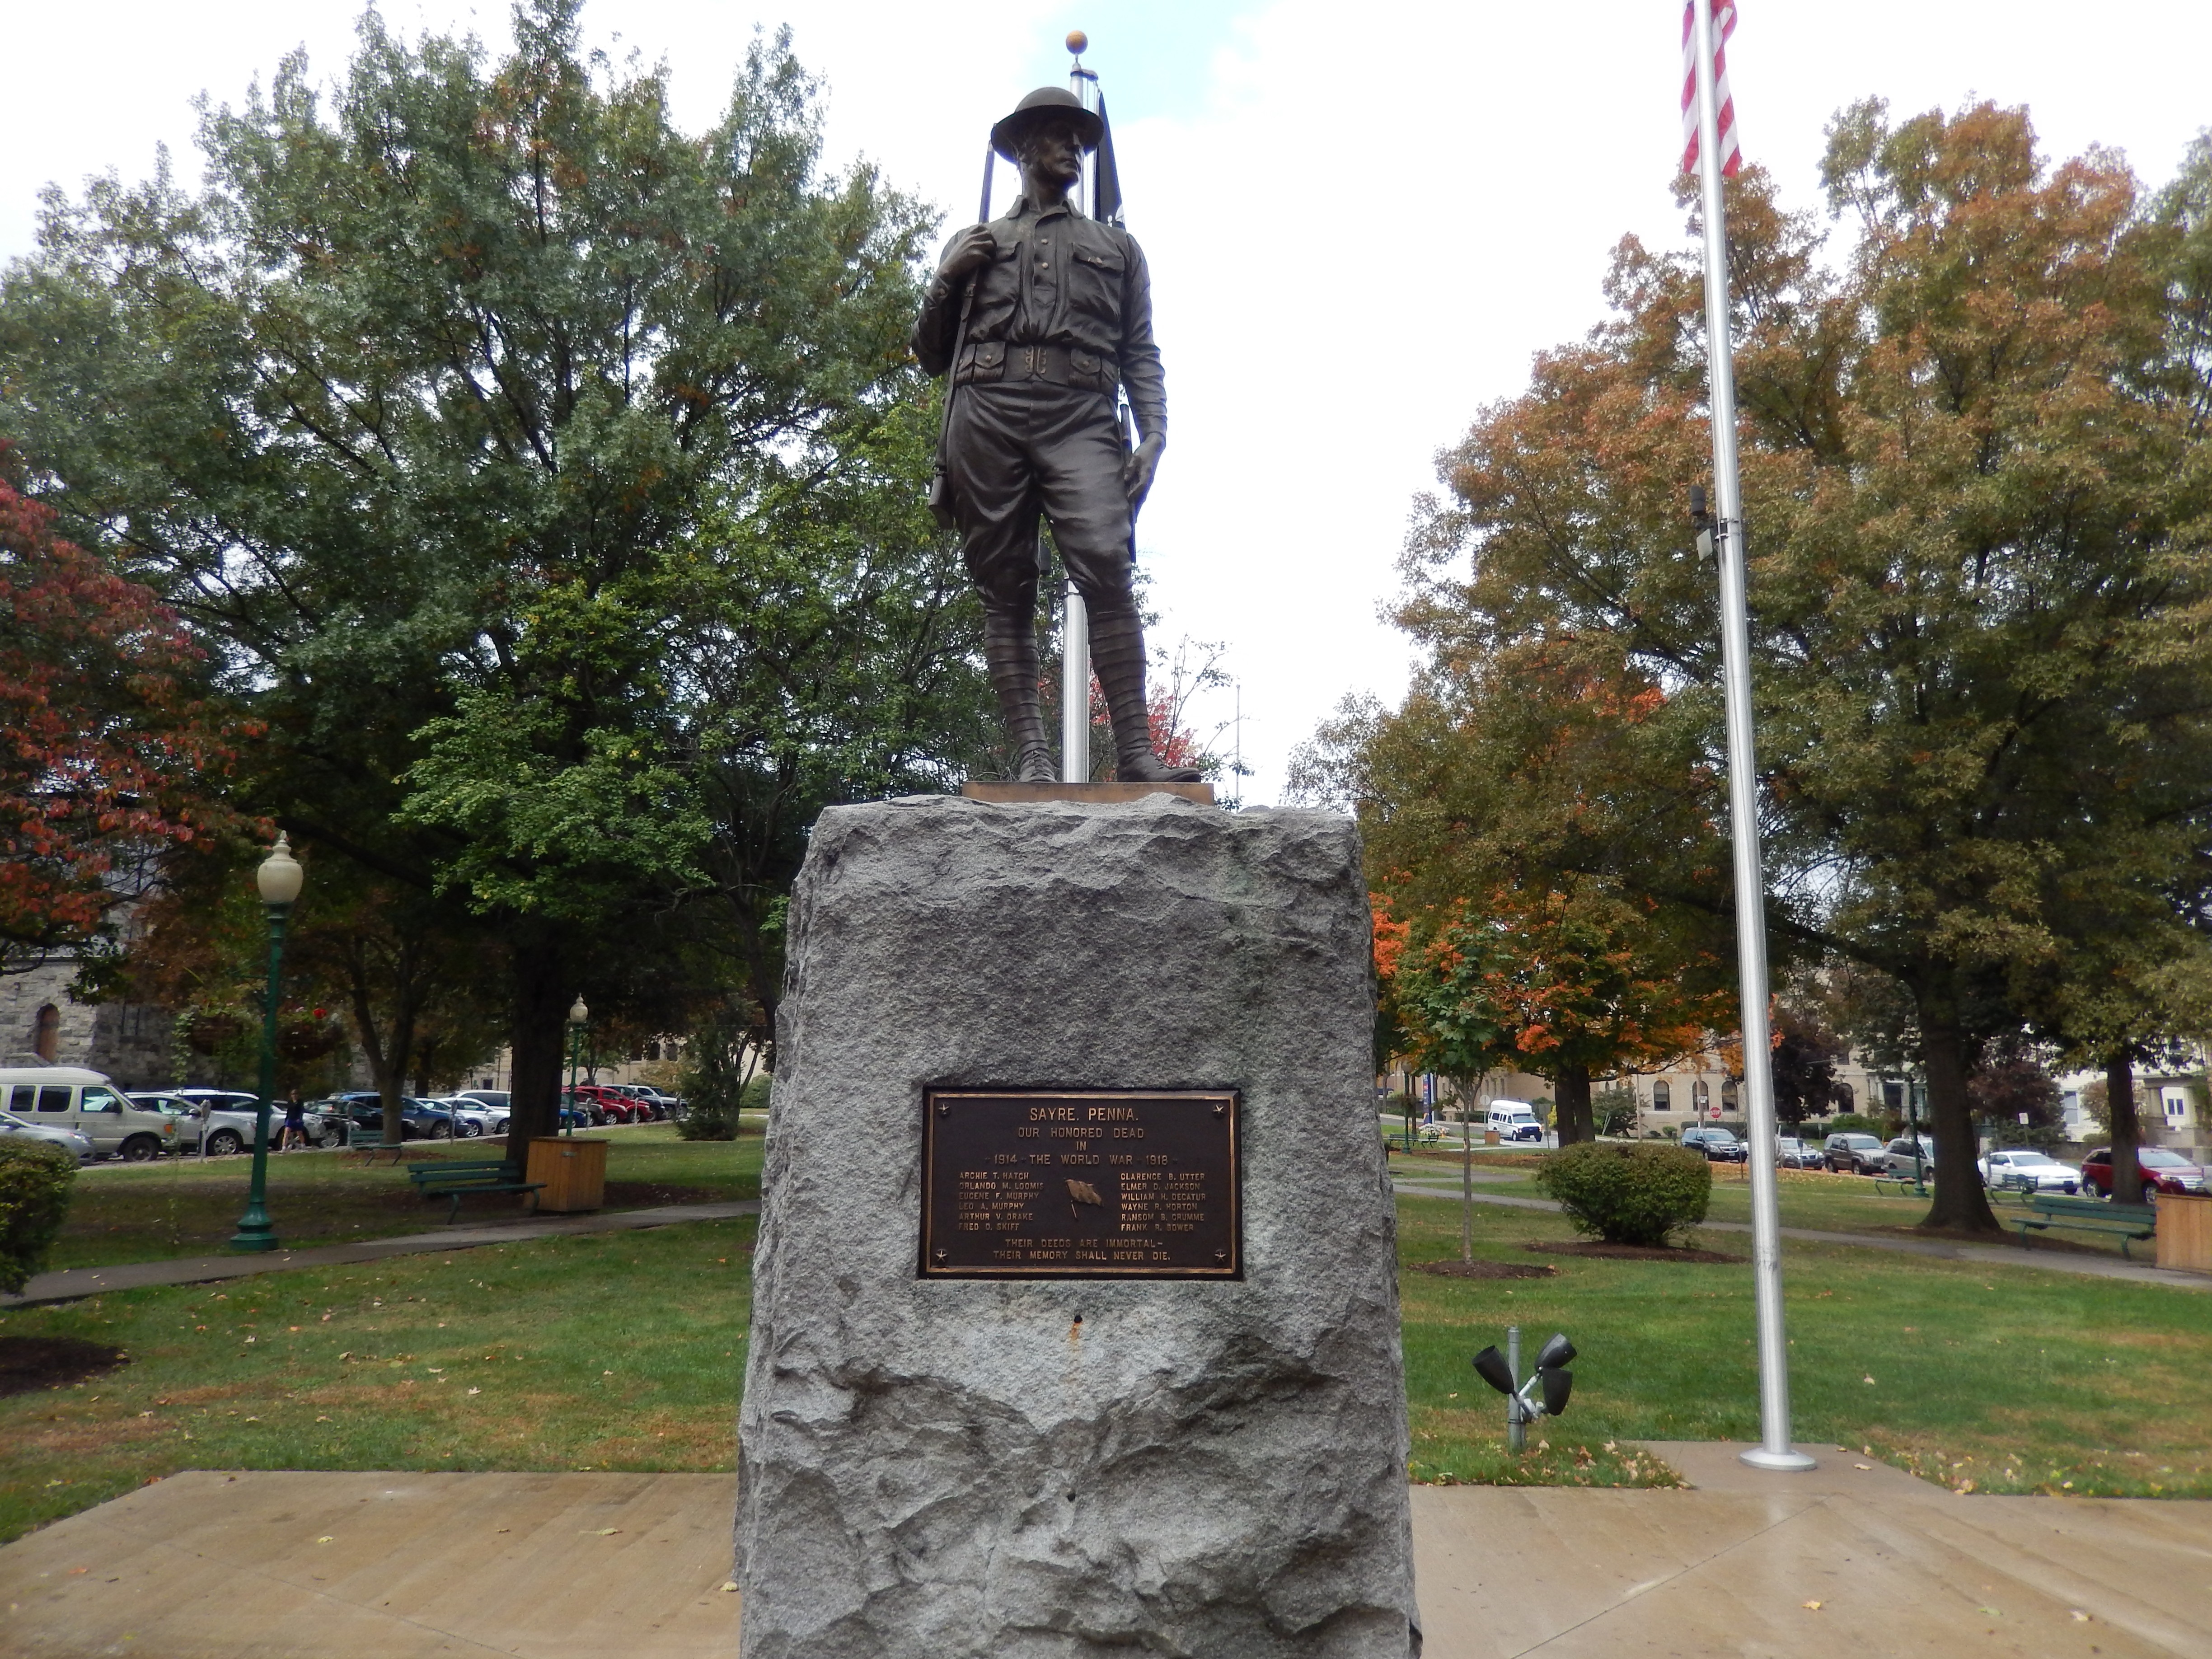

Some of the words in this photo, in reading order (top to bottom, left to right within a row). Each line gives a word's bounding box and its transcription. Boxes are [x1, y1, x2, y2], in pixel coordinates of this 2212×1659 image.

[1088, 1108, 1138, 1121] PENNA.
[1018, 1127, 1039, 1137] OUR
[1051, 1128, 1102, 1138] HONORED
[1114, 1128, 1143, 1138] DEAD
[1076, 1141, 1087, 1151] IN
[994, 1154, 1017, 1164] 1914
[1030, 1154, 1050, 1164] THE
[1060, 1154, 1099, 1165] WORLD
[1110, 1155, 1133, 1165] WAR
[1146, 1155, 1168, 1165] 1918
[1005, 1239, 1032, 1247] THEIR
[1041, 1239, 1071, 1247] DEEDS
[1080, 1239, 1098, 1247] ARE
[994, 1251, 1021, 1259] THEIR
[1030, 1251, 1068, 1259] MEMORY
[1076, 1251, 1106, 1260] SHALL
[1114, 1251, 1143, 1260] NEVER
[1153, 1251, 1170, 1260] DIE.
